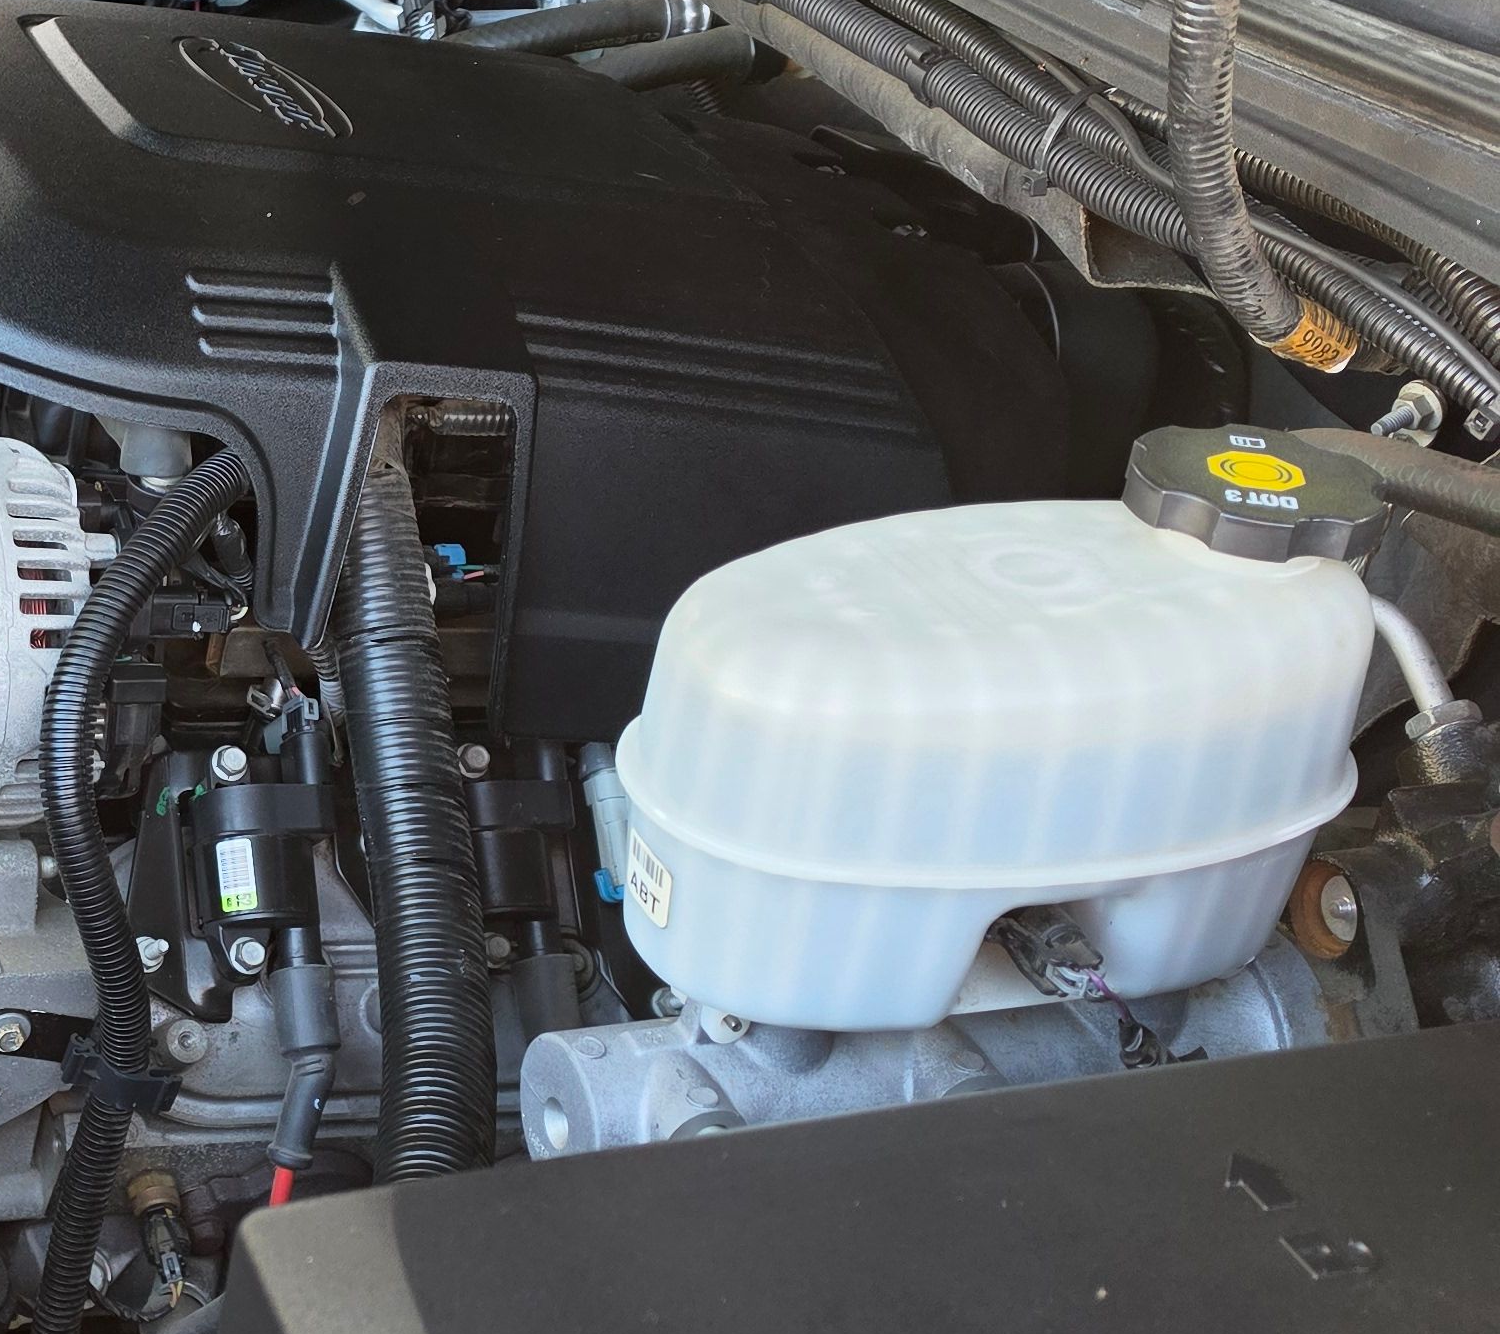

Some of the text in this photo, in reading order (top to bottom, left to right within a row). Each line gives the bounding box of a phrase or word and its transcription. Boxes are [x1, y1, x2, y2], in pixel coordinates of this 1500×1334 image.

[1296, 328, 1341, 365] 9982
[1224, 488, 1300, 510] DOT 3
[630, 870, 660, 914] ABT
